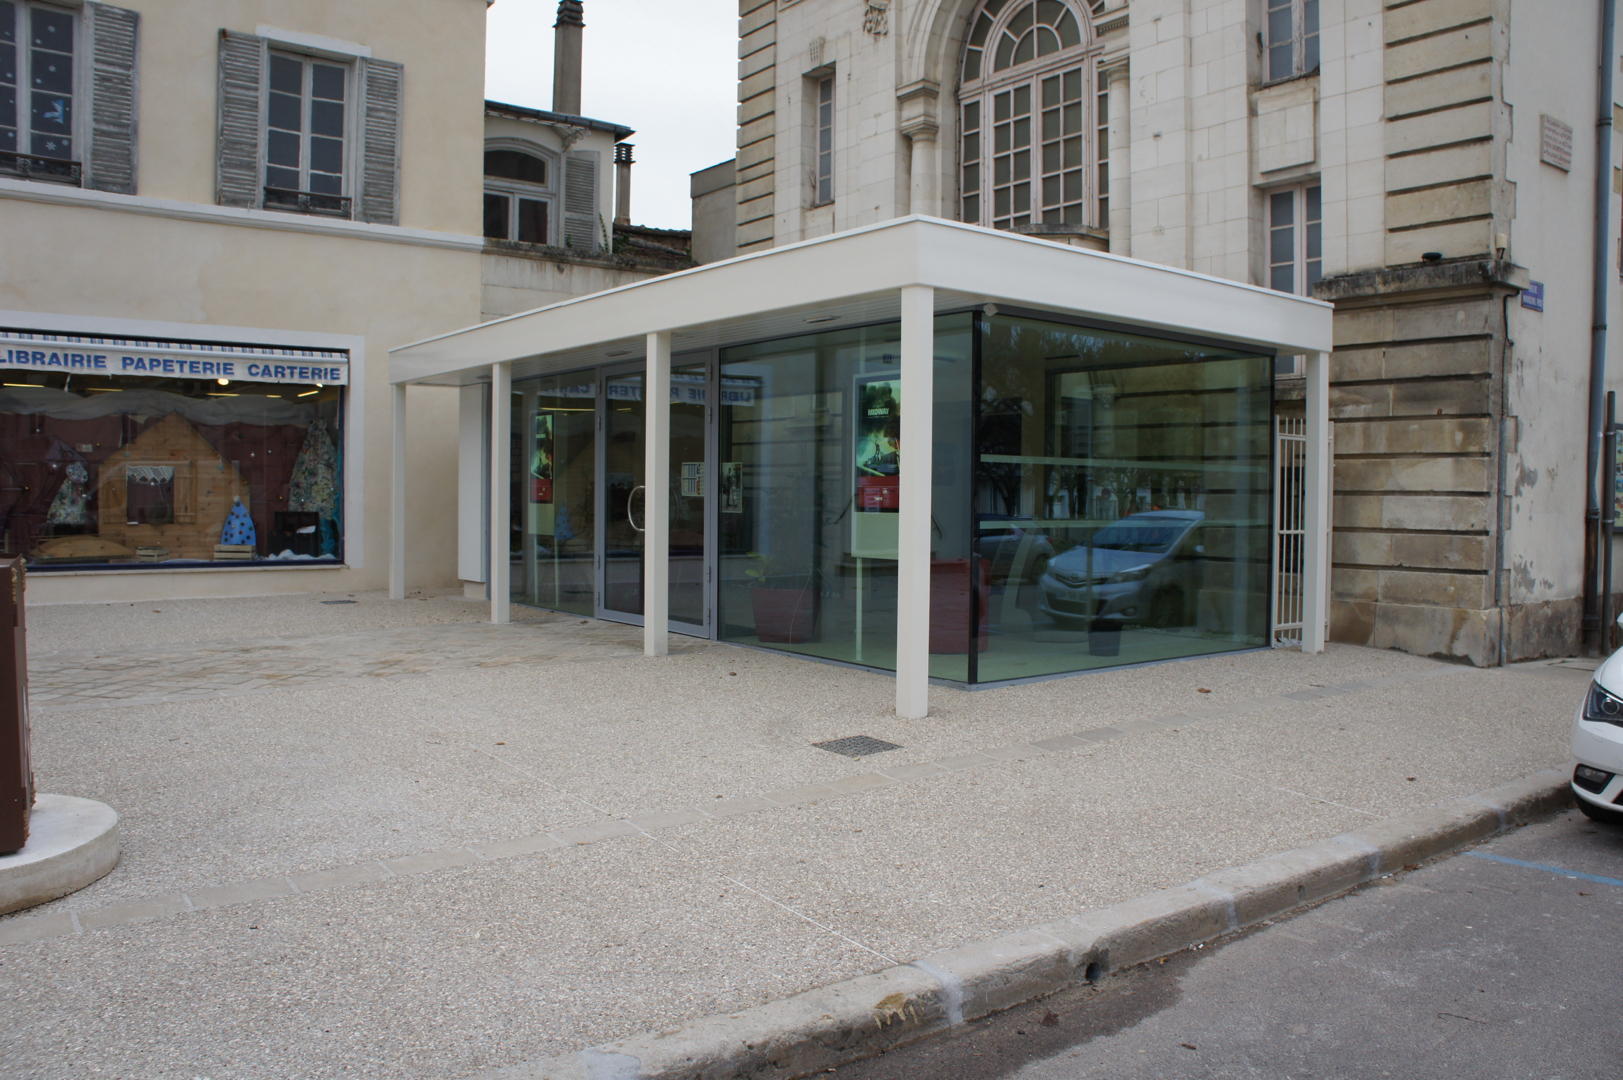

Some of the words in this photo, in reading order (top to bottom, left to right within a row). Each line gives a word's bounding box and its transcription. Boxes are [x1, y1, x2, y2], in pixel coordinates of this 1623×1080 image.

[121, 356, 235, 376] PAPETERIE
[247, 363, 341, 380] CARTERIE
[867, 407, 890, 416] MIDWAY
